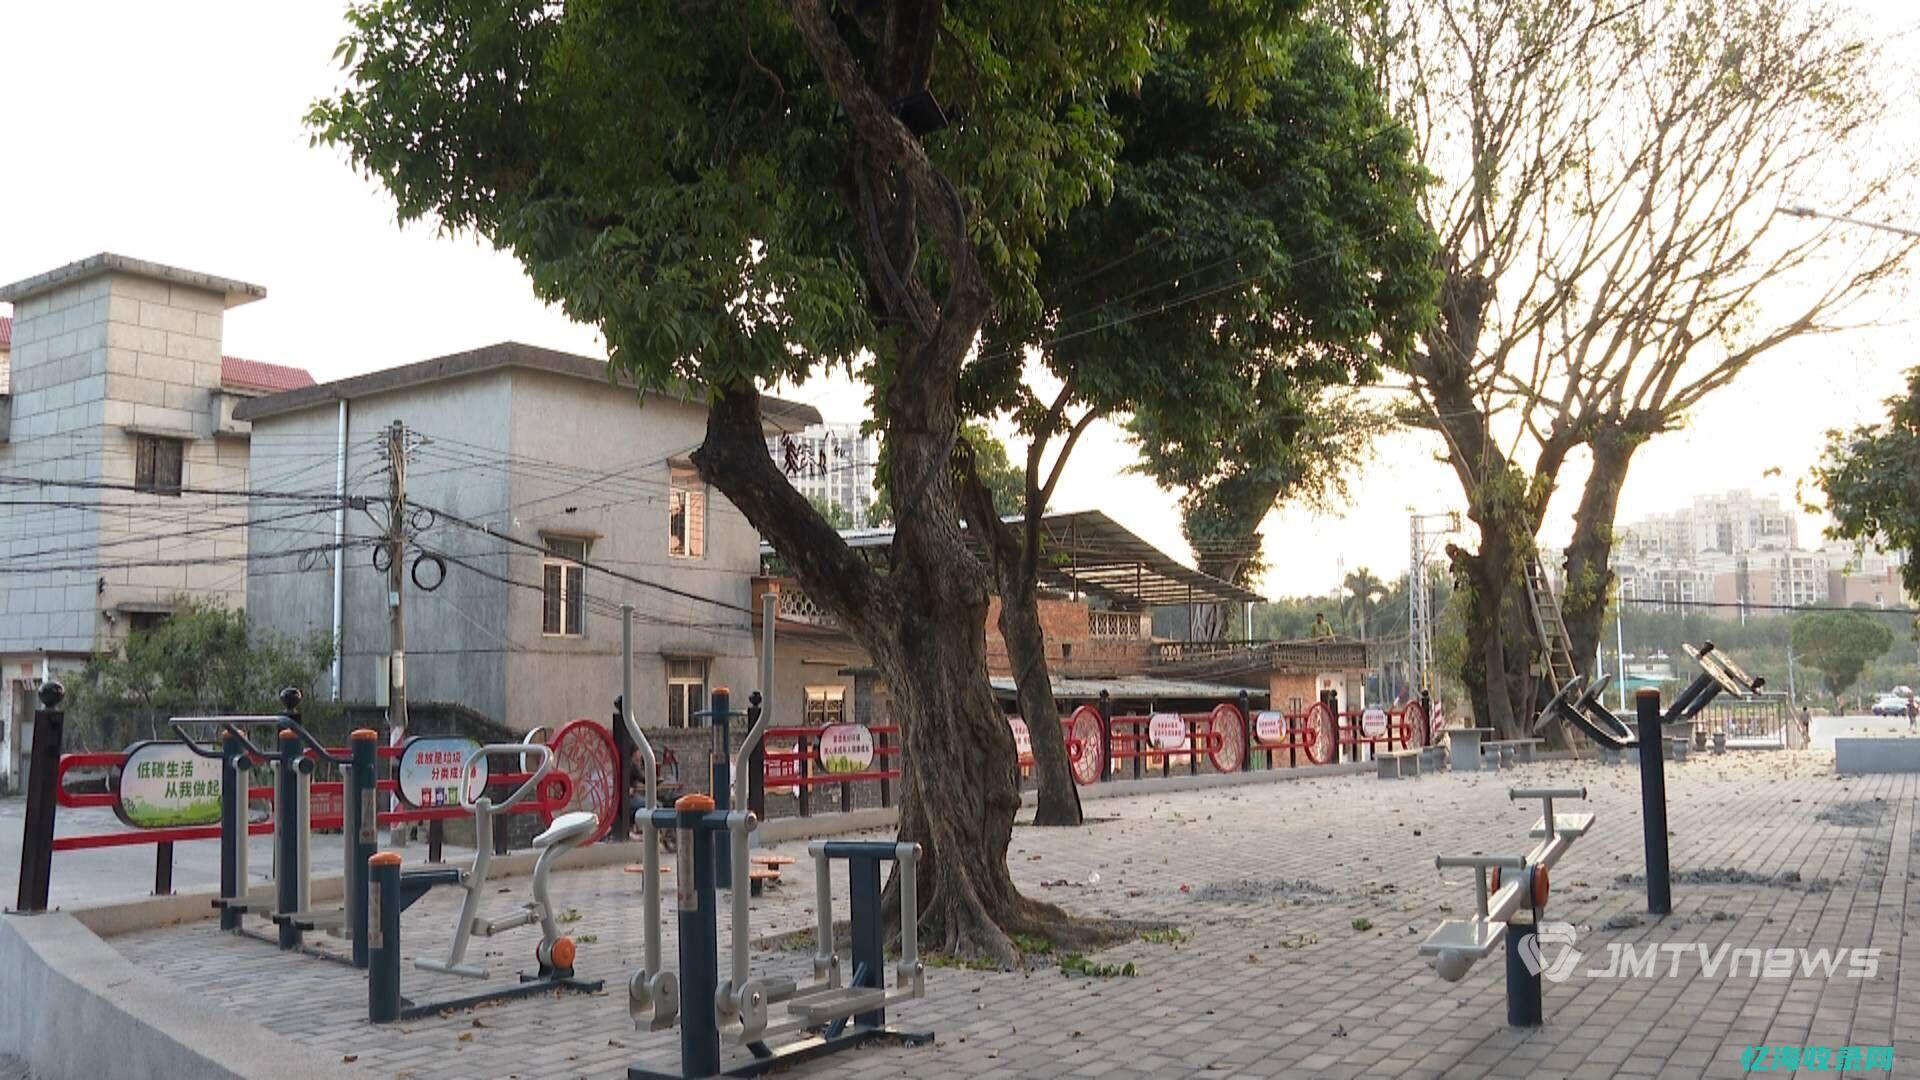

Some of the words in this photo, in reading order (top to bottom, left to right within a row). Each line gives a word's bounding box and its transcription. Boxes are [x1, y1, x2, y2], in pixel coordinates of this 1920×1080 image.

[137, 760, 193, 779] 低碳生活
[432, 767, 477, 780] 分类成源
[165, 780, 220, 798] 从我做起
